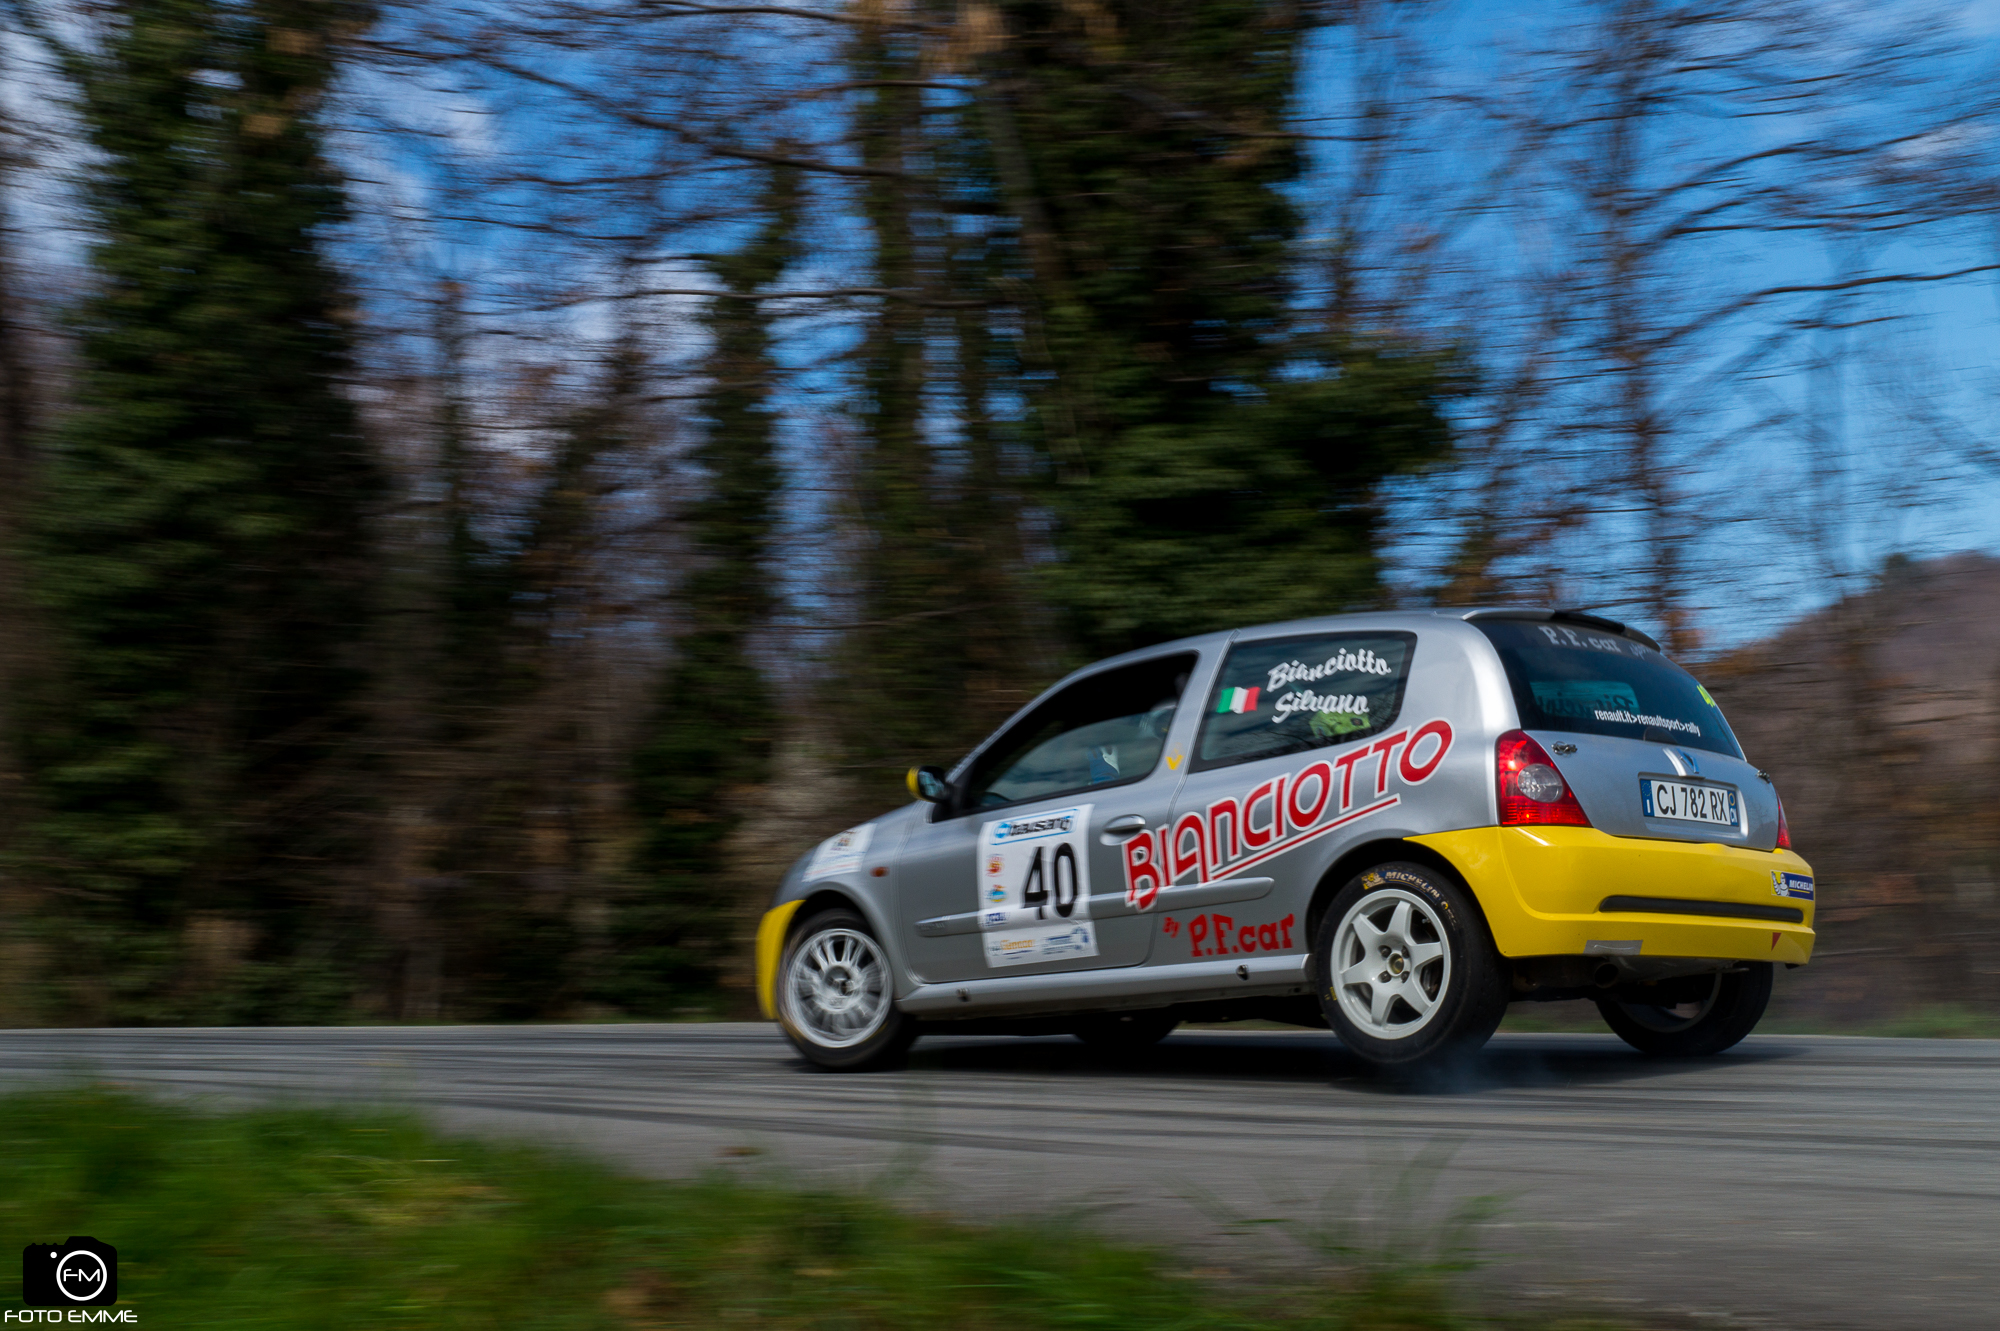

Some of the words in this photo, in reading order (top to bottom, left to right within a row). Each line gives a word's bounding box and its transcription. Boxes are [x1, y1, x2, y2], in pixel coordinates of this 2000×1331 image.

[1267, 648, 1392, 693] Bianciotto
[1272, 690, 1370, 724] Silvano
[1123, 718, 1454, 912] BIANCIOTTO
[1657, 784, 1677, 816] CJ
[1680, 787, 1708, 819] 782
[1709, 790, 1728, 822] RX
[1021, 842, 1079, 921] 40
[1384, 871, 1441, 899] MICHELIN
[1789, 879, 1813, 892] MICHELIN
